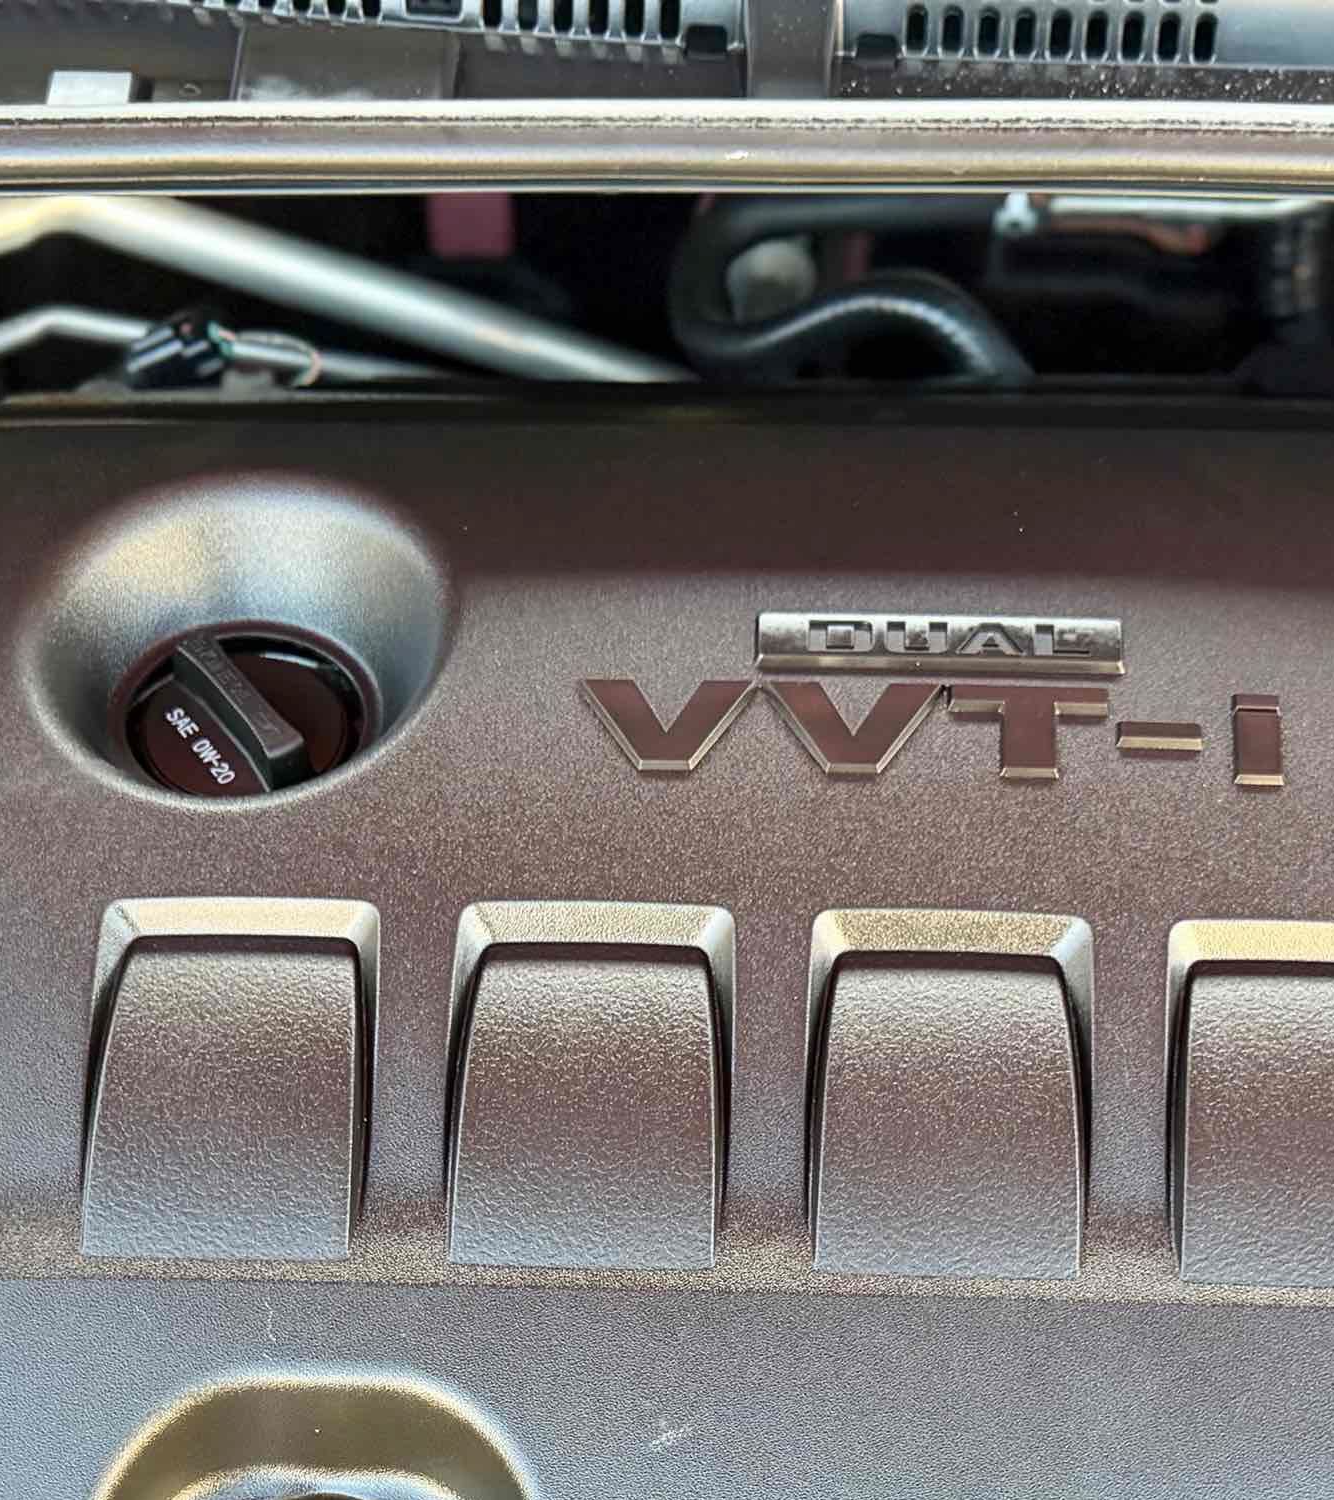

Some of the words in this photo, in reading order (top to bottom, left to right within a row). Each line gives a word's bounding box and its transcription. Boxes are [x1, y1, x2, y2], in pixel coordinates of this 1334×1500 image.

[806, 619, 1092, 656] DUAL
[166, 707, 199, 739] SAE
[191, 738, 236, 785] 0W-20
